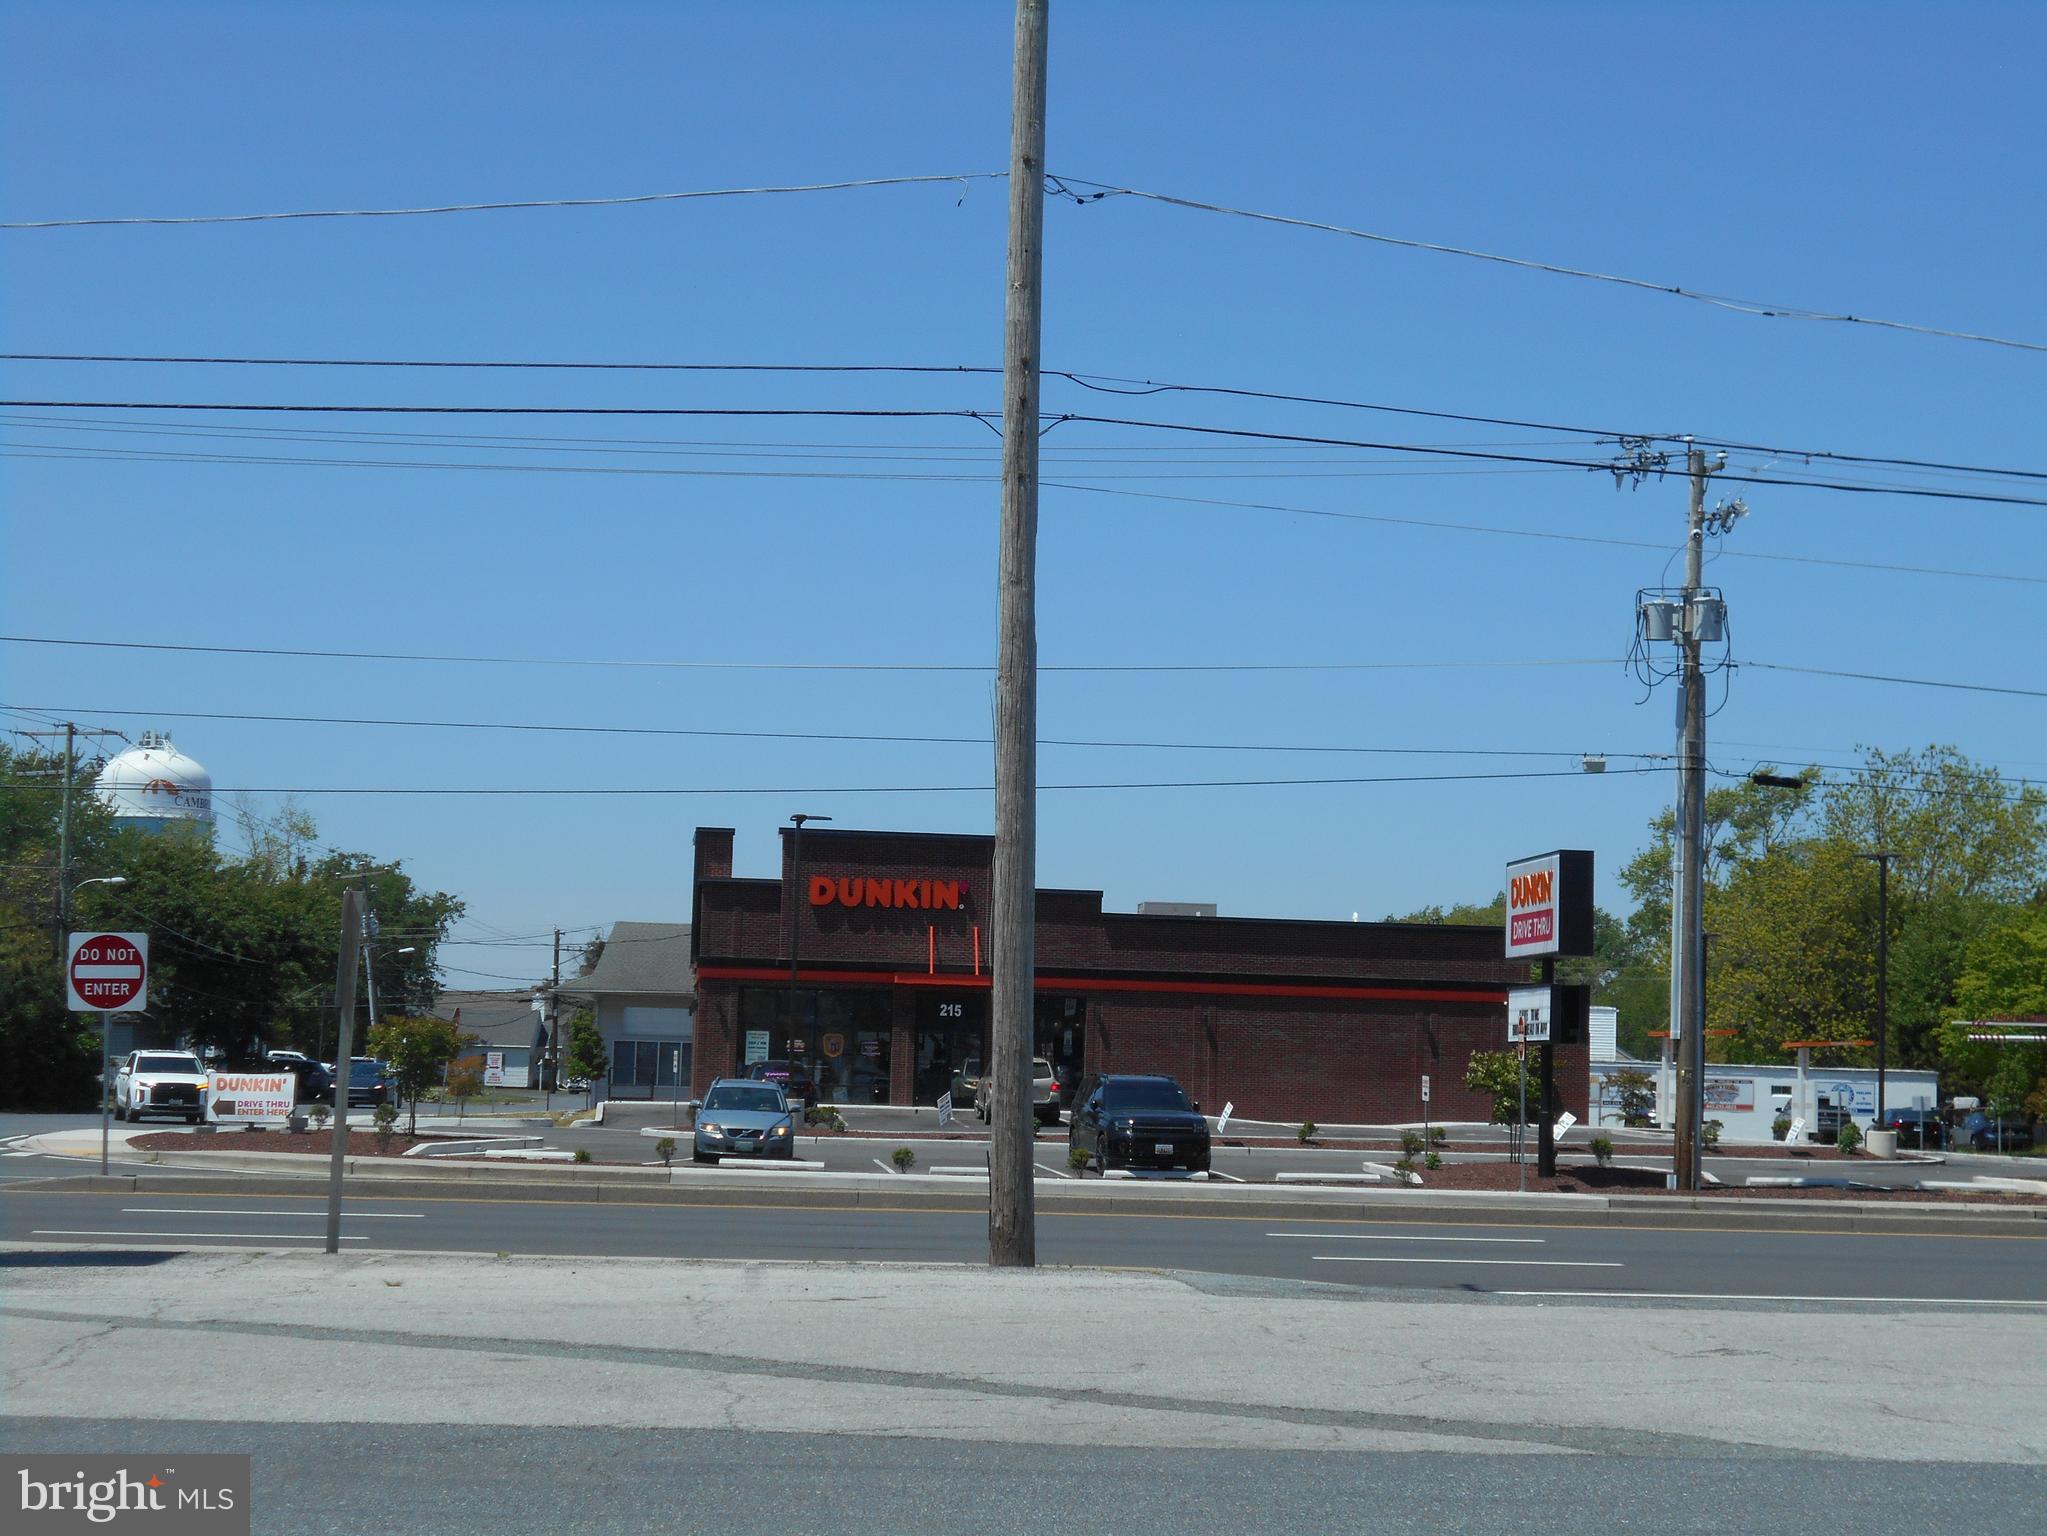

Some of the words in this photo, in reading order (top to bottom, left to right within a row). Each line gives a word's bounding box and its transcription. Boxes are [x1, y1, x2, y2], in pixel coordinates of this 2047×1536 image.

[1513, 919, 1532, 940] DRIVE
[1533, 916, 1551, 937] THRU
[80, 948, 100, 961] DO
[106, 948, 136, 961] NOT
[84, 983, 130, 996] ENTER
[940, 1003, 962, 1017] 215
[216, 1077, 287, 1092] DUNKIN'
[237, 1100, 263, 1108] DRIVE
[266, 1100, 290, 1108] THRU
[237, 1108, 264, 1116] ENTER
[266, 1108, 289, 1116] HERE
